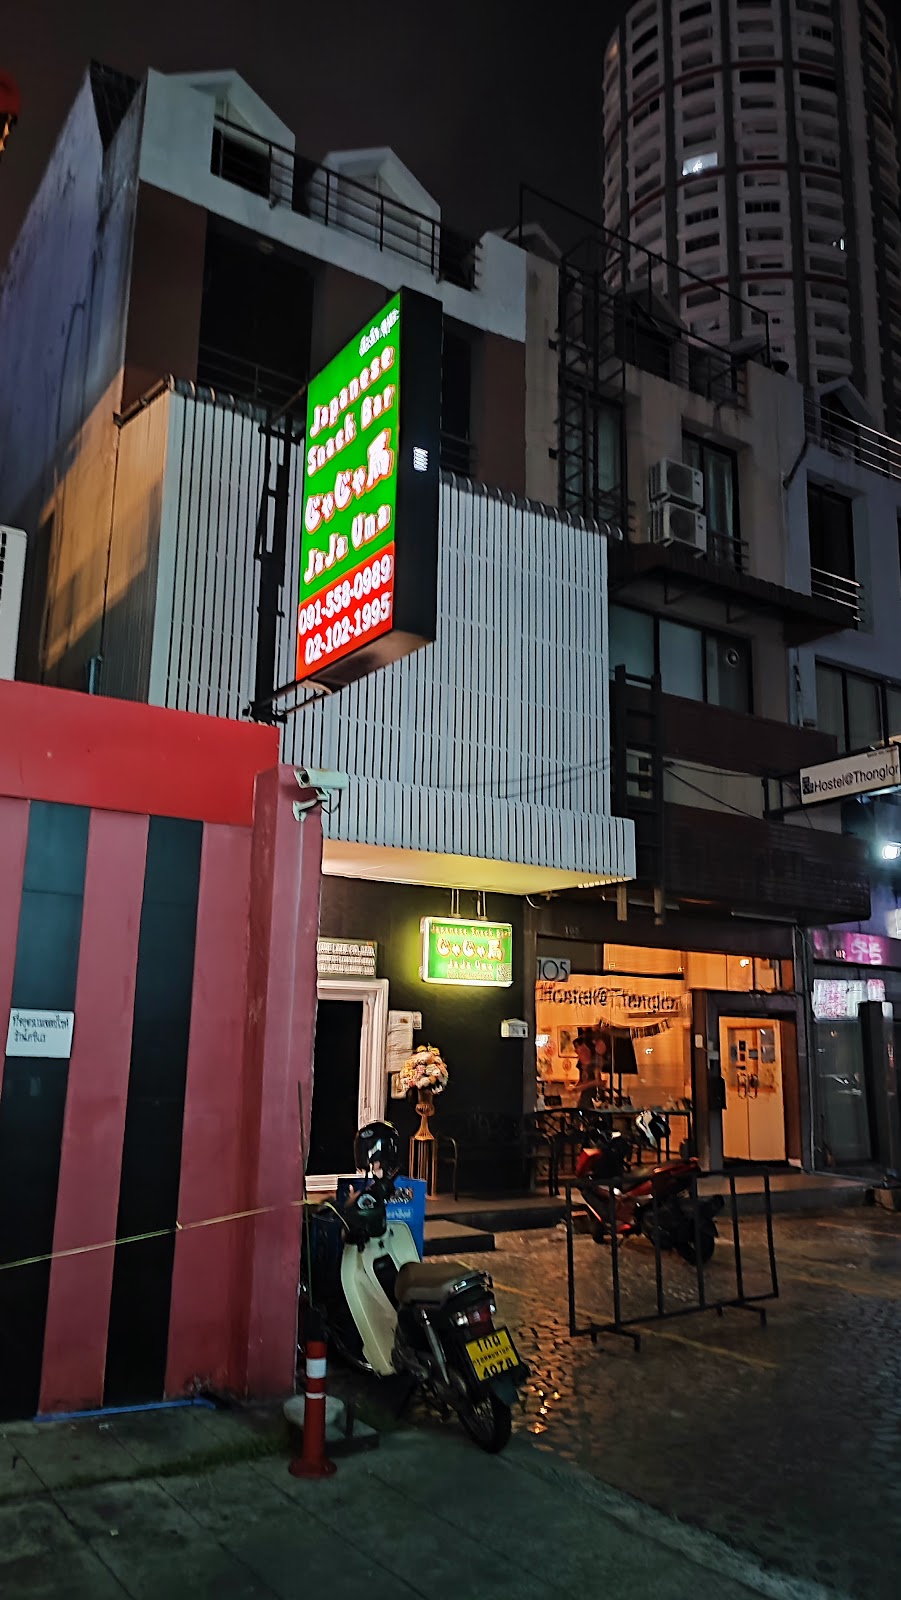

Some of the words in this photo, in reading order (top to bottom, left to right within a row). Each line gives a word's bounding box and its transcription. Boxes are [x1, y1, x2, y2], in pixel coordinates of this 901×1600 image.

[309, 345, 395, 438] Japanese
[307, 411, 357, 477] Snack
[361, 384, 395, 431] Bar
[303, 532, 349, 584] JaJa
[351, 505, 391, 550] Uma
[298, 554, 394, 636] 091-558-0989
[304, 591, 393, 666] 02-102-1995
[814, 764, 899, 793] Hostel@Thonglor
[430, 924, 468, 936] Japanese
[471, 927, 494, 938] Snack
[537, 960, 568, 982] 105
